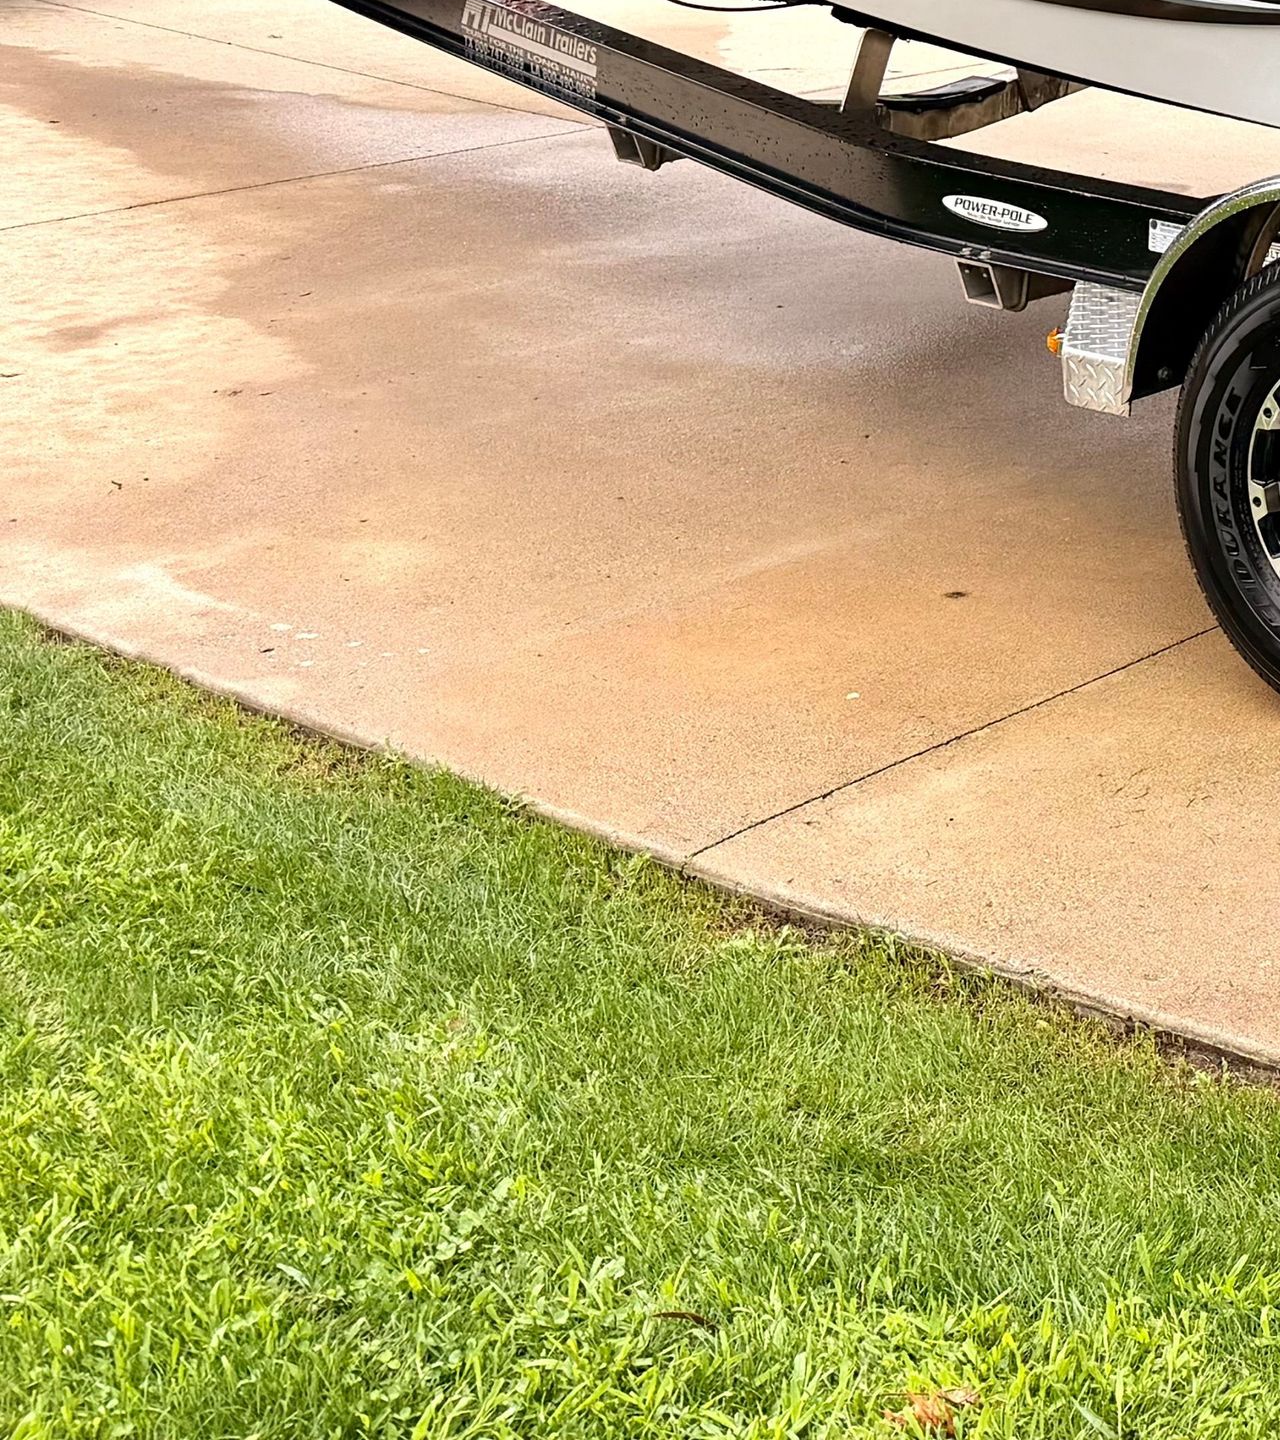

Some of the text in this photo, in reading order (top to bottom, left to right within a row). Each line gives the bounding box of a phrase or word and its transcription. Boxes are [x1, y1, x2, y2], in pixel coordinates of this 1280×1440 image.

[493, 6, 597, 65] McClain Trailers
[954, 197, 1035, 225] POWER-POLE
